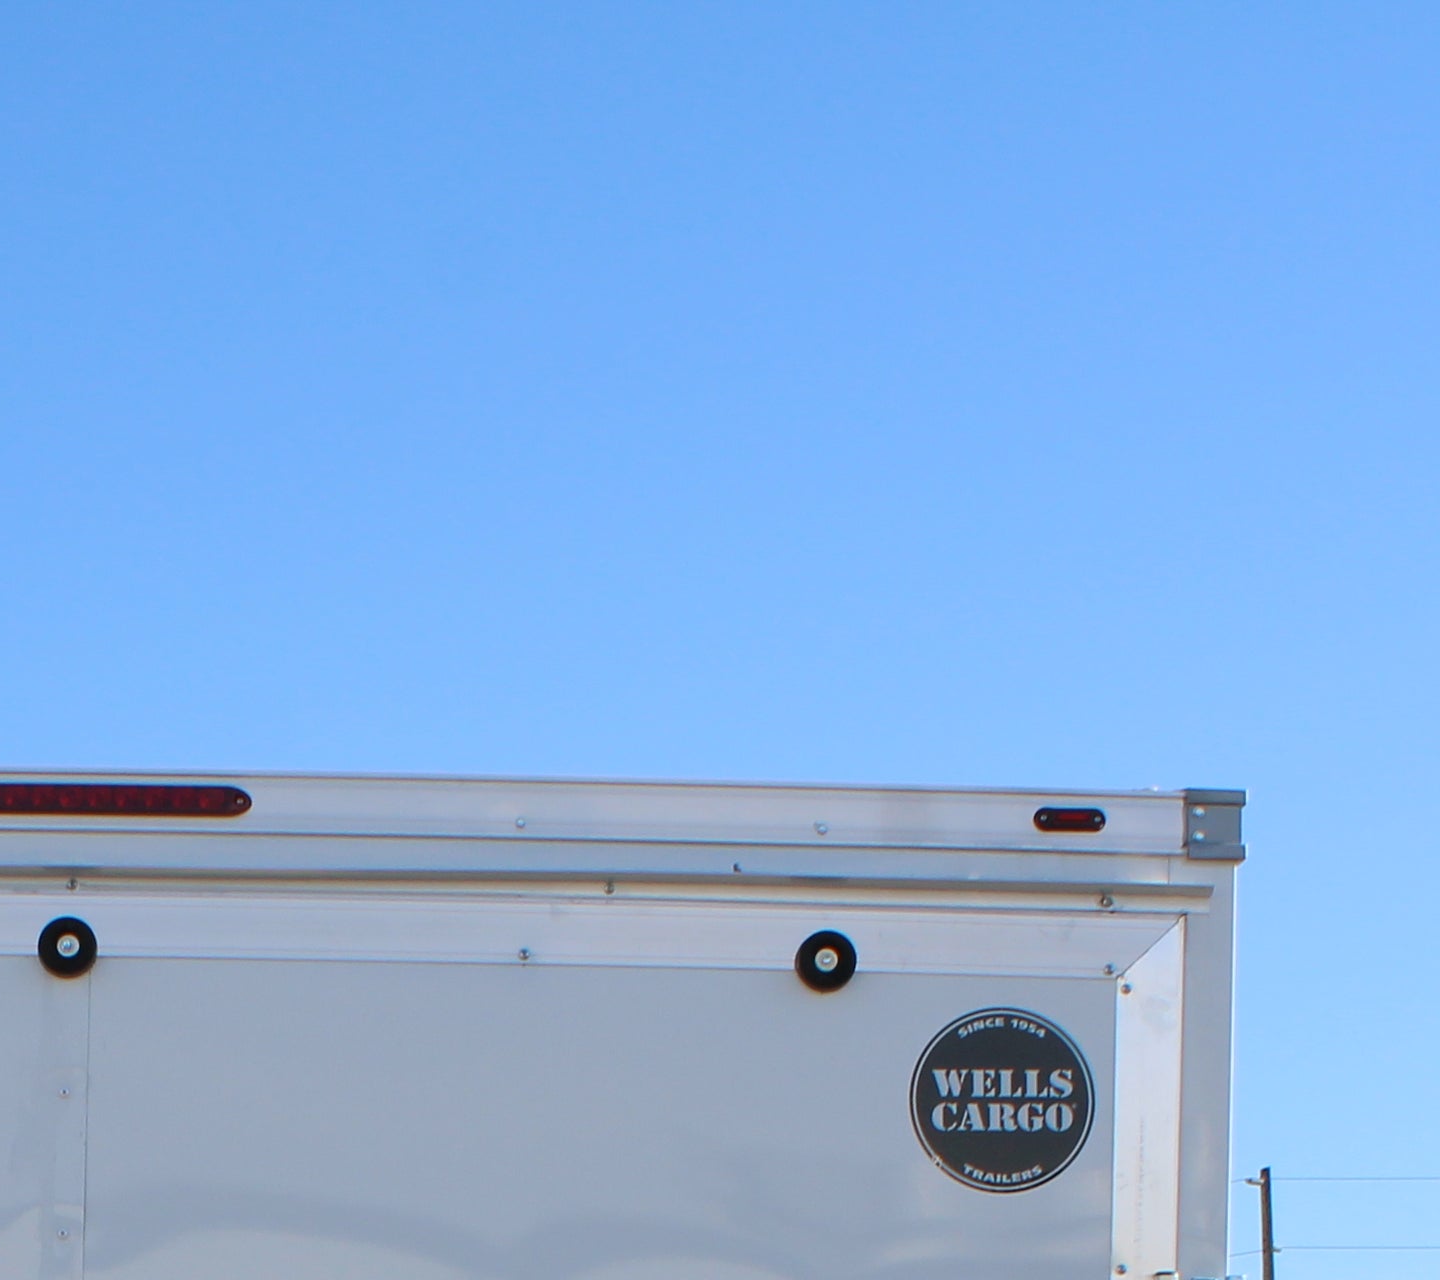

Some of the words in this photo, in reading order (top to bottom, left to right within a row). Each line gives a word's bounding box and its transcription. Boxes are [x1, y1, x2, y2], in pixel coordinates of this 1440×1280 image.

[957, 1017, 1005, 1038] SINCE
[1010, 1018, 1047, 1038] 1954
[932, 1069, 1074, 1098] WELLS
[931, 1102, 1073, 1132] CARGO
[963, 1163, 1043, 1183] TRAILERS
